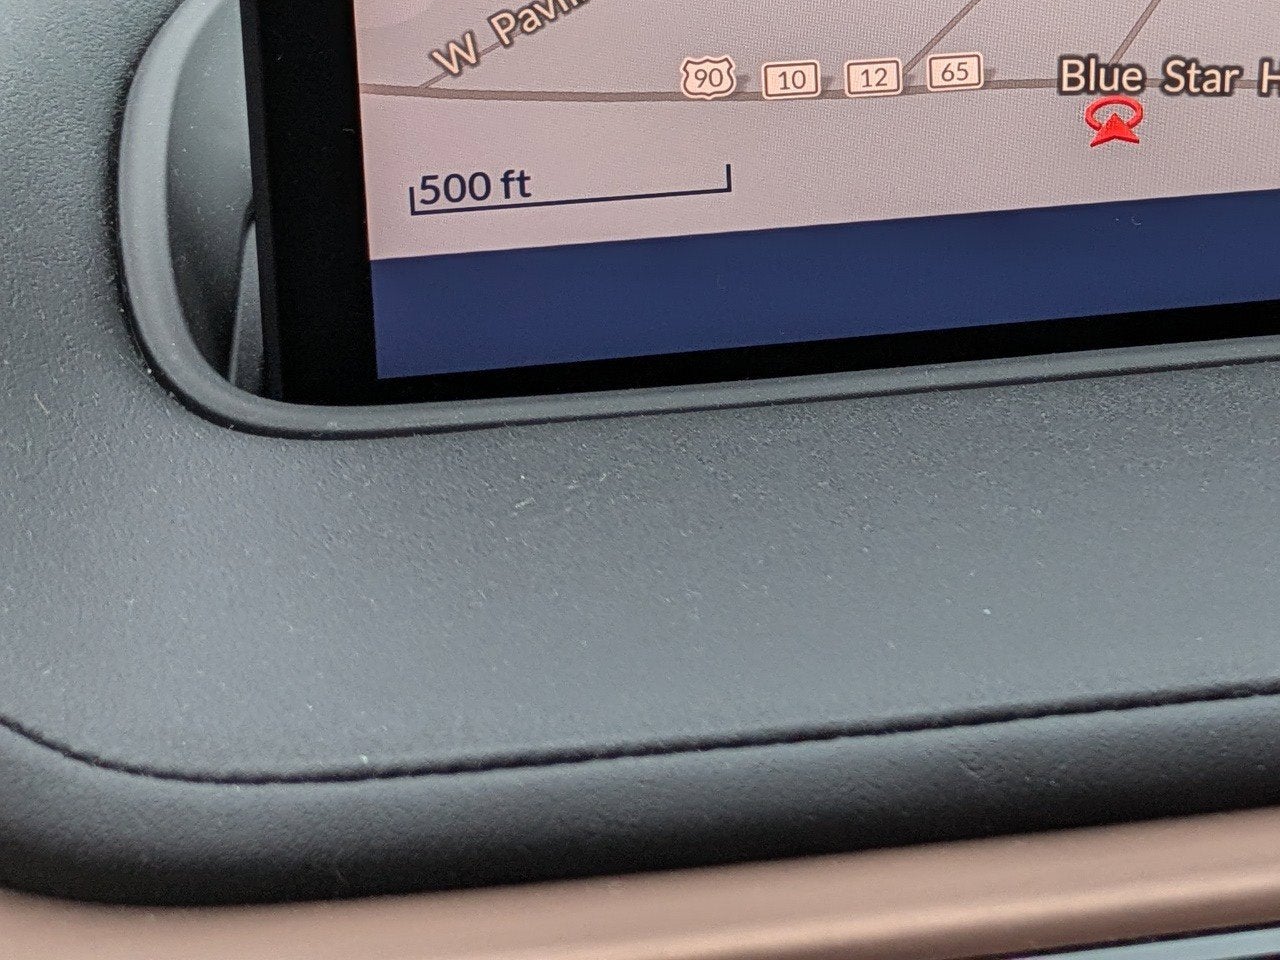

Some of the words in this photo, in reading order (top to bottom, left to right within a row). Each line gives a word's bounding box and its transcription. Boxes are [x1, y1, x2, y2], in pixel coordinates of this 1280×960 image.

[431, 32, 478, 74] W
[694, 67, 724, 88] 90
[777, 70, 807, 90] 10
[860, 67, 888, 88] 12
[941, 61, 970, 82] 65
[1062, 58, 1142, 92] Blue
[1164, 59, 1239, 93] Star
[420, 171, 491, 205] 500
[500, 169, 532, 199] ft
